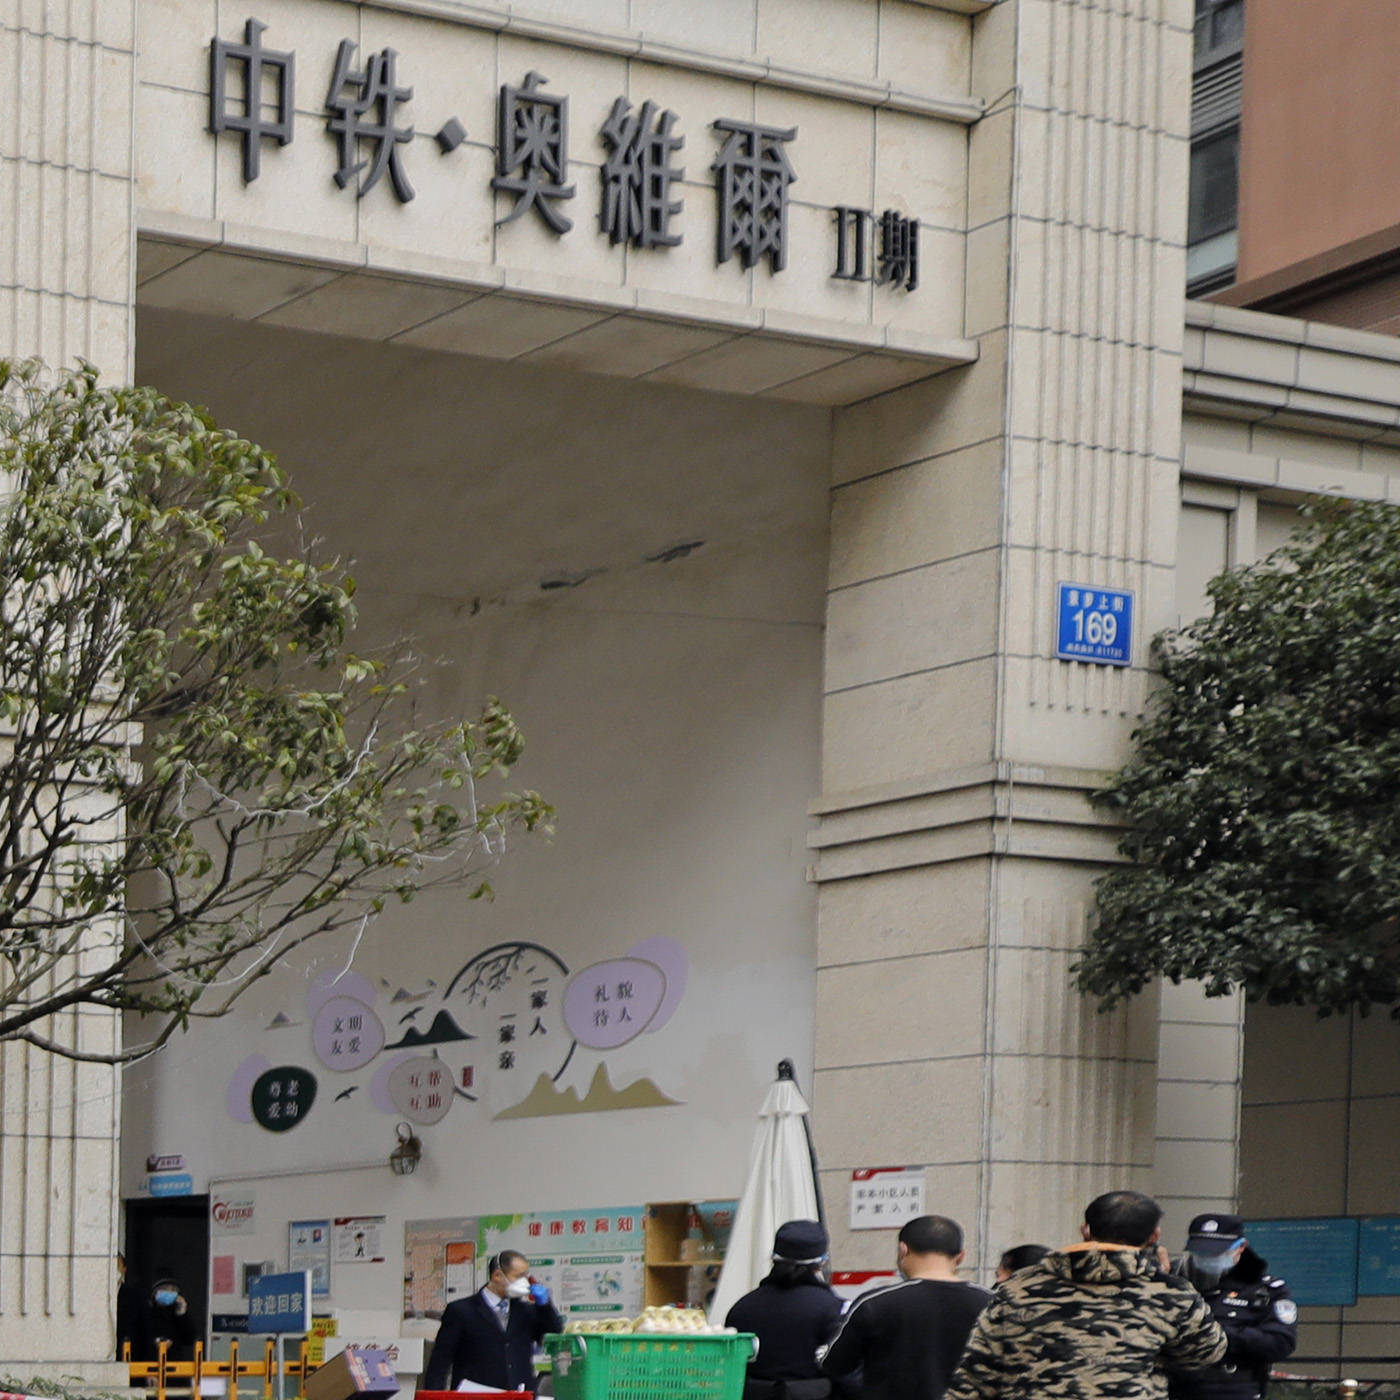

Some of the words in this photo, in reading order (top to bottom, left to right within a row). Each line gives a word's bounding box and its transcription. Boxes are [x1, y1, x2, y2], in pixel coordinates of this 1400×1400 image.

[1072, 609, 1118, 646] 169
[528, 1216, 647, 1238] 健康教育知
[251, 1292, 304, 1316] 欢迎回家
